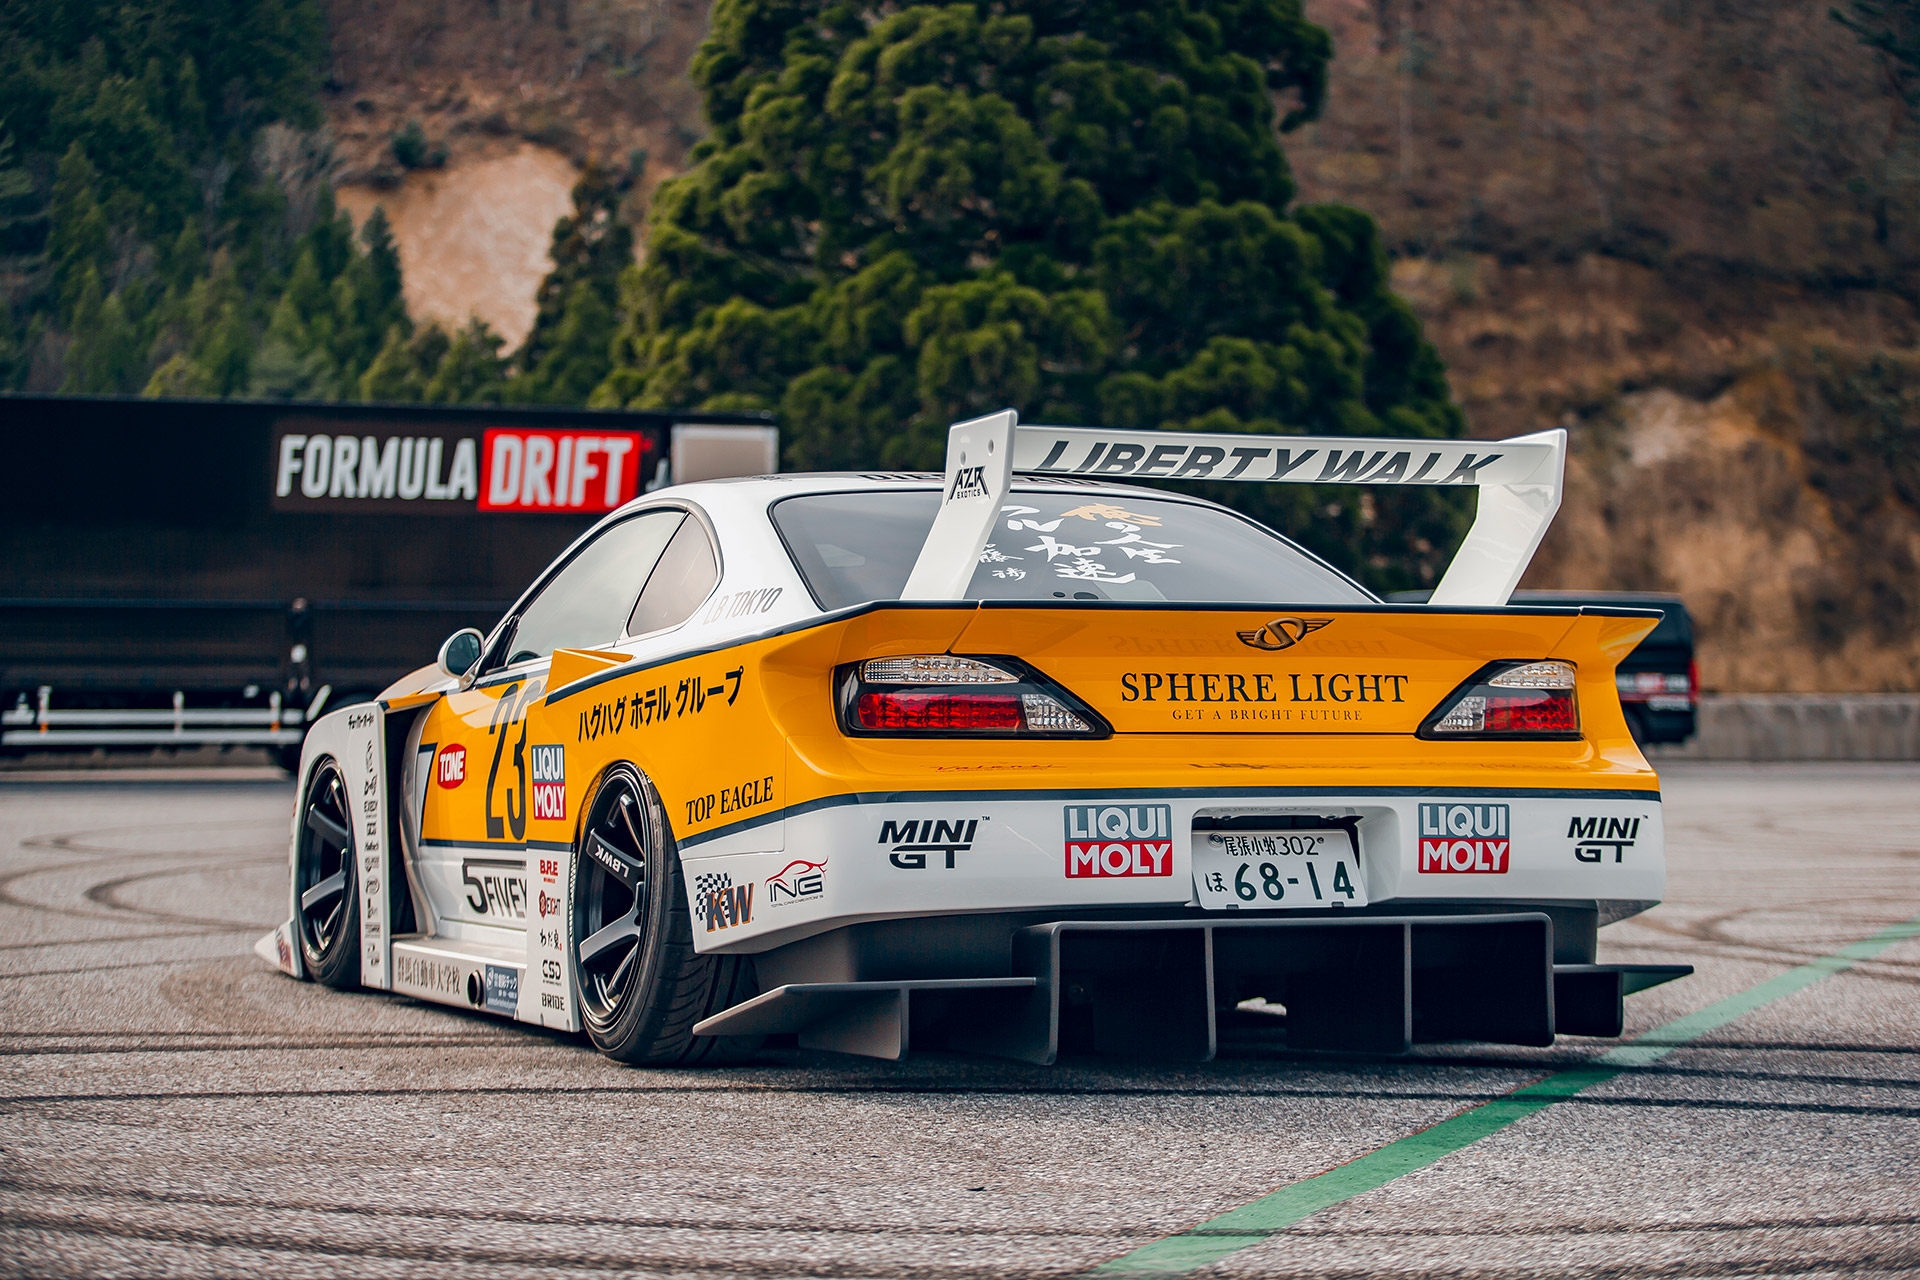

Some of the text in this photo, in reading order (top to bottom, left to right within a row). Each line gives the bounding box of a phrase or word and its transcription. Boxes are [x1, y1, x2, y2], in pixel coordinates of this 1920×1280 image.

[276, 433, 478, 500] FORMULA
[488, 434, 634, 507] DRIFT
[1033, 440, 1504, 484] LIBERTY WALK
[957, 489, 981, 499] EXOTICS
[703, 587, 783, 625] LB TOKYO
[1121, 672, 1409, 703] SPHERE LIGHT
[578, 665, 744, 743] ハグハグ ホテル グループ
[1172, 709, 1363, 721] GET A BRIGHT FUTURE
[440, 751, 465, 783] TONE
[485, 679, 544, 841] 23
[533, 747, 564, 782] LIQUI
[534, 785, 566, 818] MOLY
[686, 776, 774, 825] TOP EAGLE
[878, 819, 979, 844] MINI
[1069, 806, 1166, 841] LIQUI
[1422, 805, 1506, 838] LIQUI
[1567, 817, 1640, 839] MINI
[594, 844, 630, 878] LBWK
[889, 844, 973, 869] GT
[1070, 843, 1171, 875] MOLY
[1423, 841, 1508, 871] MOLY
[1574, 840, 1634, 863] GT
[770, 873, 823, 902] ING
[1205, 860, 1356, 901] ほ 68-14
[706, 882, 754, 932] KW
[542, 959, 562, 980] CSD
[541, 992, 566, 1011] BRIDE
